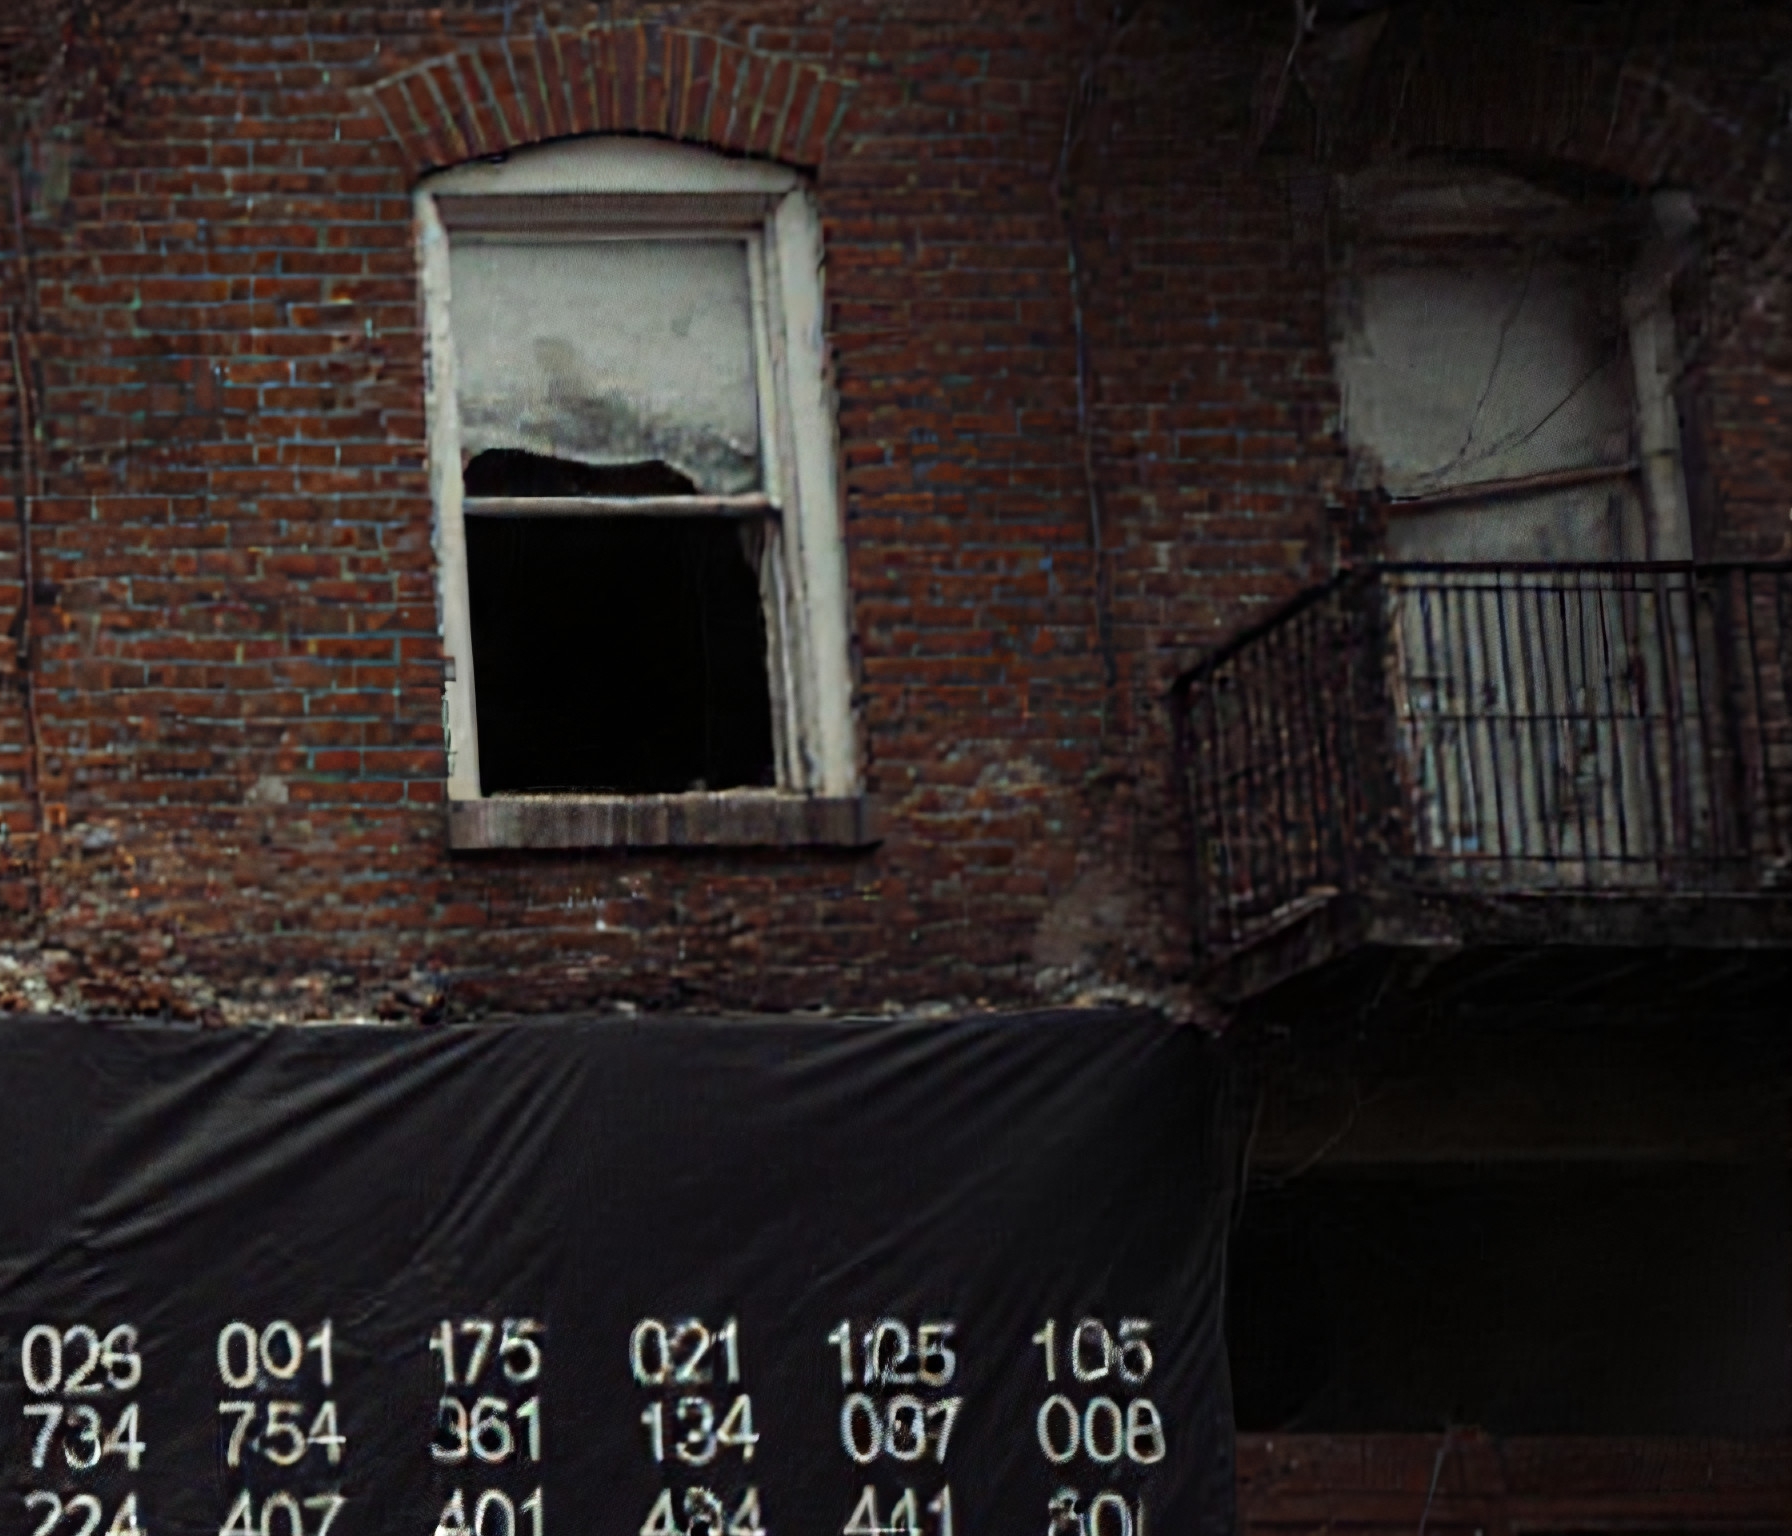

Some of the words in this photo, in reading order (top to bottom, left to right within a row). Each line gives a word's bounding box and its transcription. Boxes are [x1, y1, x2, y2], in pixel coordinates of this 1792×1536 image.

[217, 1320, 333, 1390] 001
[429, 1318, 542, 1385] 175
[630, 1317, 740, 1385] 021
[219, 1400, 347, 1467] 754
[1036, 1394, 1166, 1464] 008
